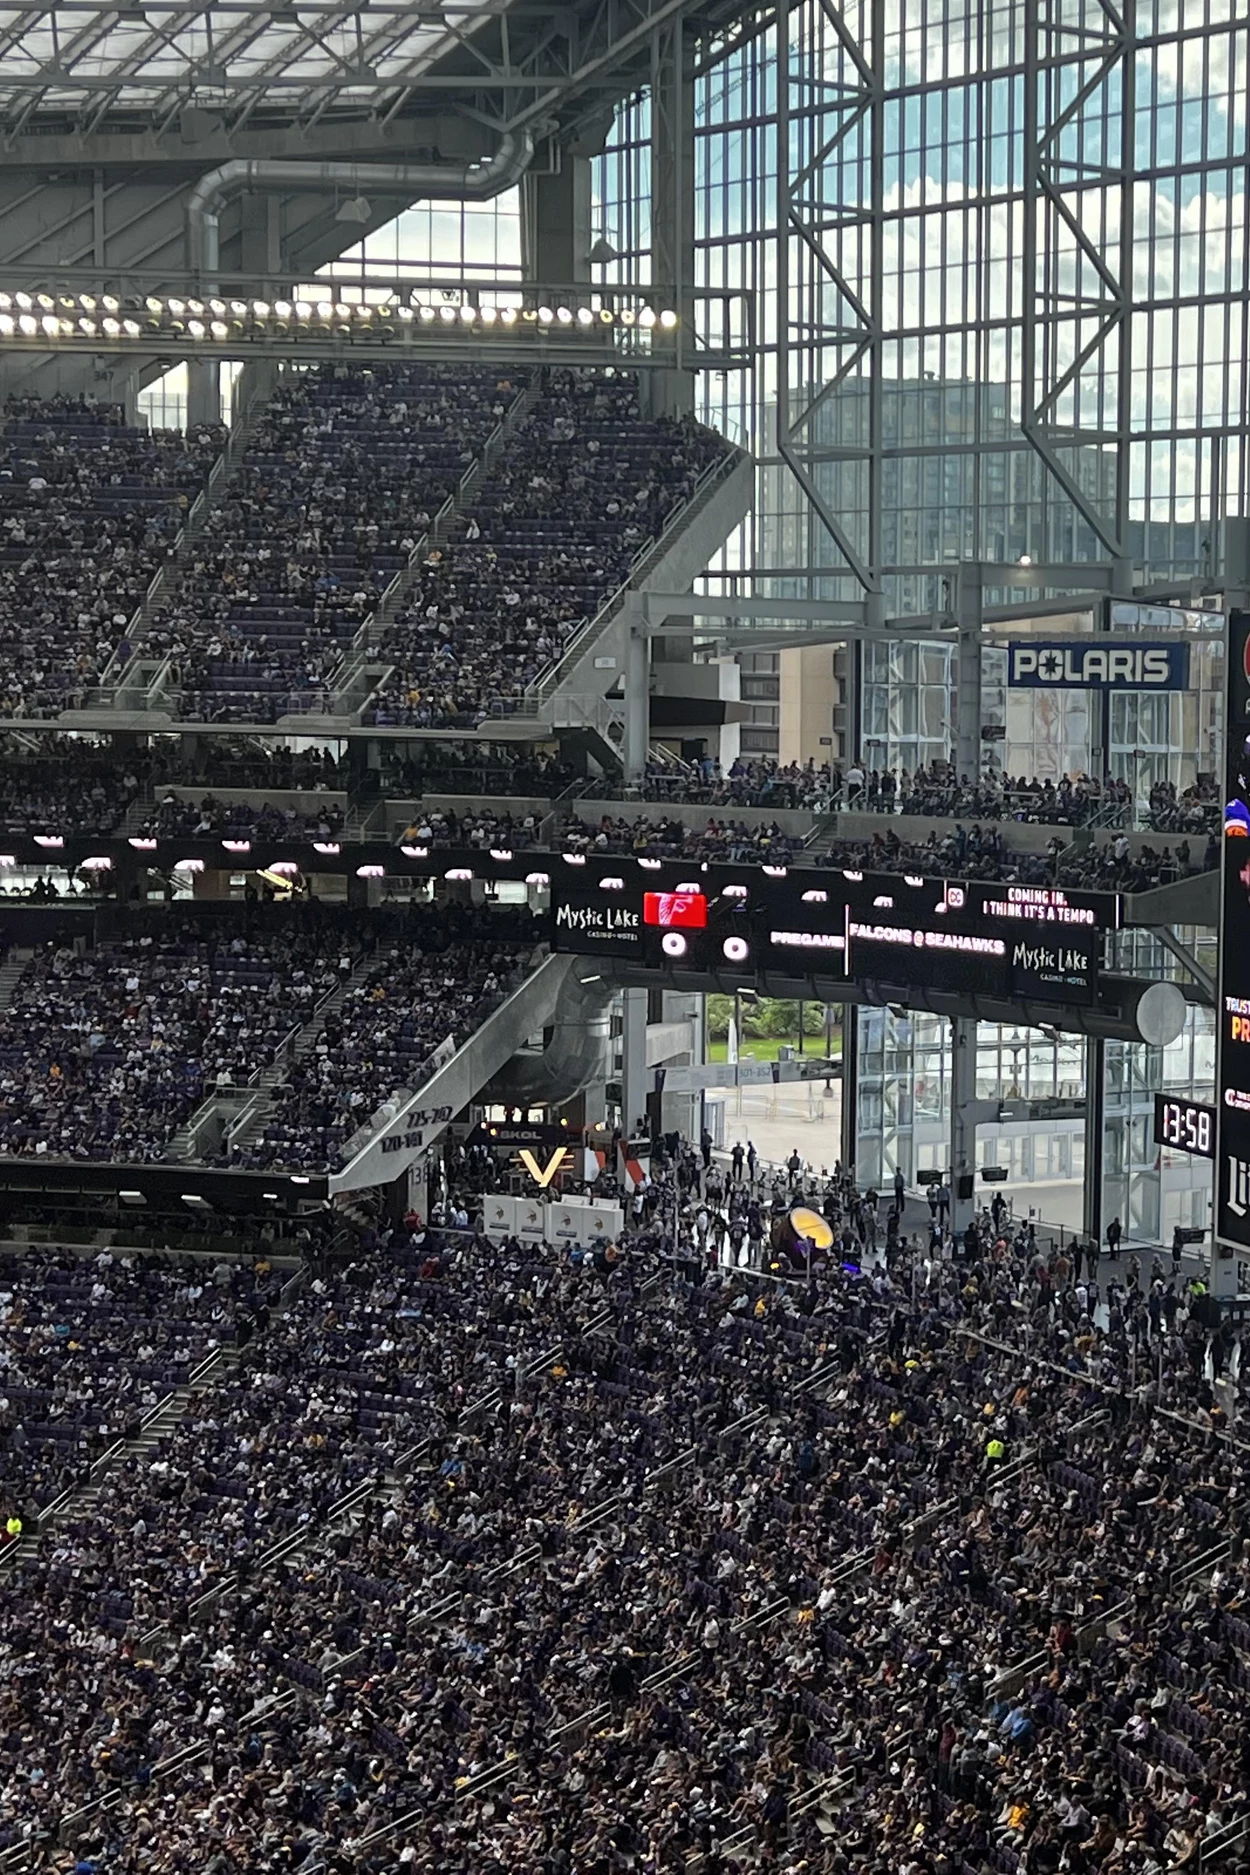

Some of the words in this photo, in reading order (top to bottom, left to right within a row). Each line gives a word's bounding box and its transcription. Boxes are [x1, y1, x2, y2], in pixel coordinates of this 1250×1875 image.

[1014, 649, 1171, 683] POLARIS
[1008, 887, 1049, 903] COMING
[556, 903, 604, 930] Mystic
[983, 901, 988, 914] I
[989, 901, 1021, 917] THINK
[1024, 904, 1045, 919] IT'S
[1047, 907, 1055, 921] A
[1058, 908, 1094, 924] TEMPO
[662, 932, 686, 956] 0
[723, 936, 748, 960] 0
[771, 931, 845, 948] PREGAME
[849, 923, 912, 943] FALCONS
[925, 931, 1005, 955] SEAHAWKS
[1013, 941, 1055, 970] Mystic
[1163, 1104, 1209, 1151] 13:58
